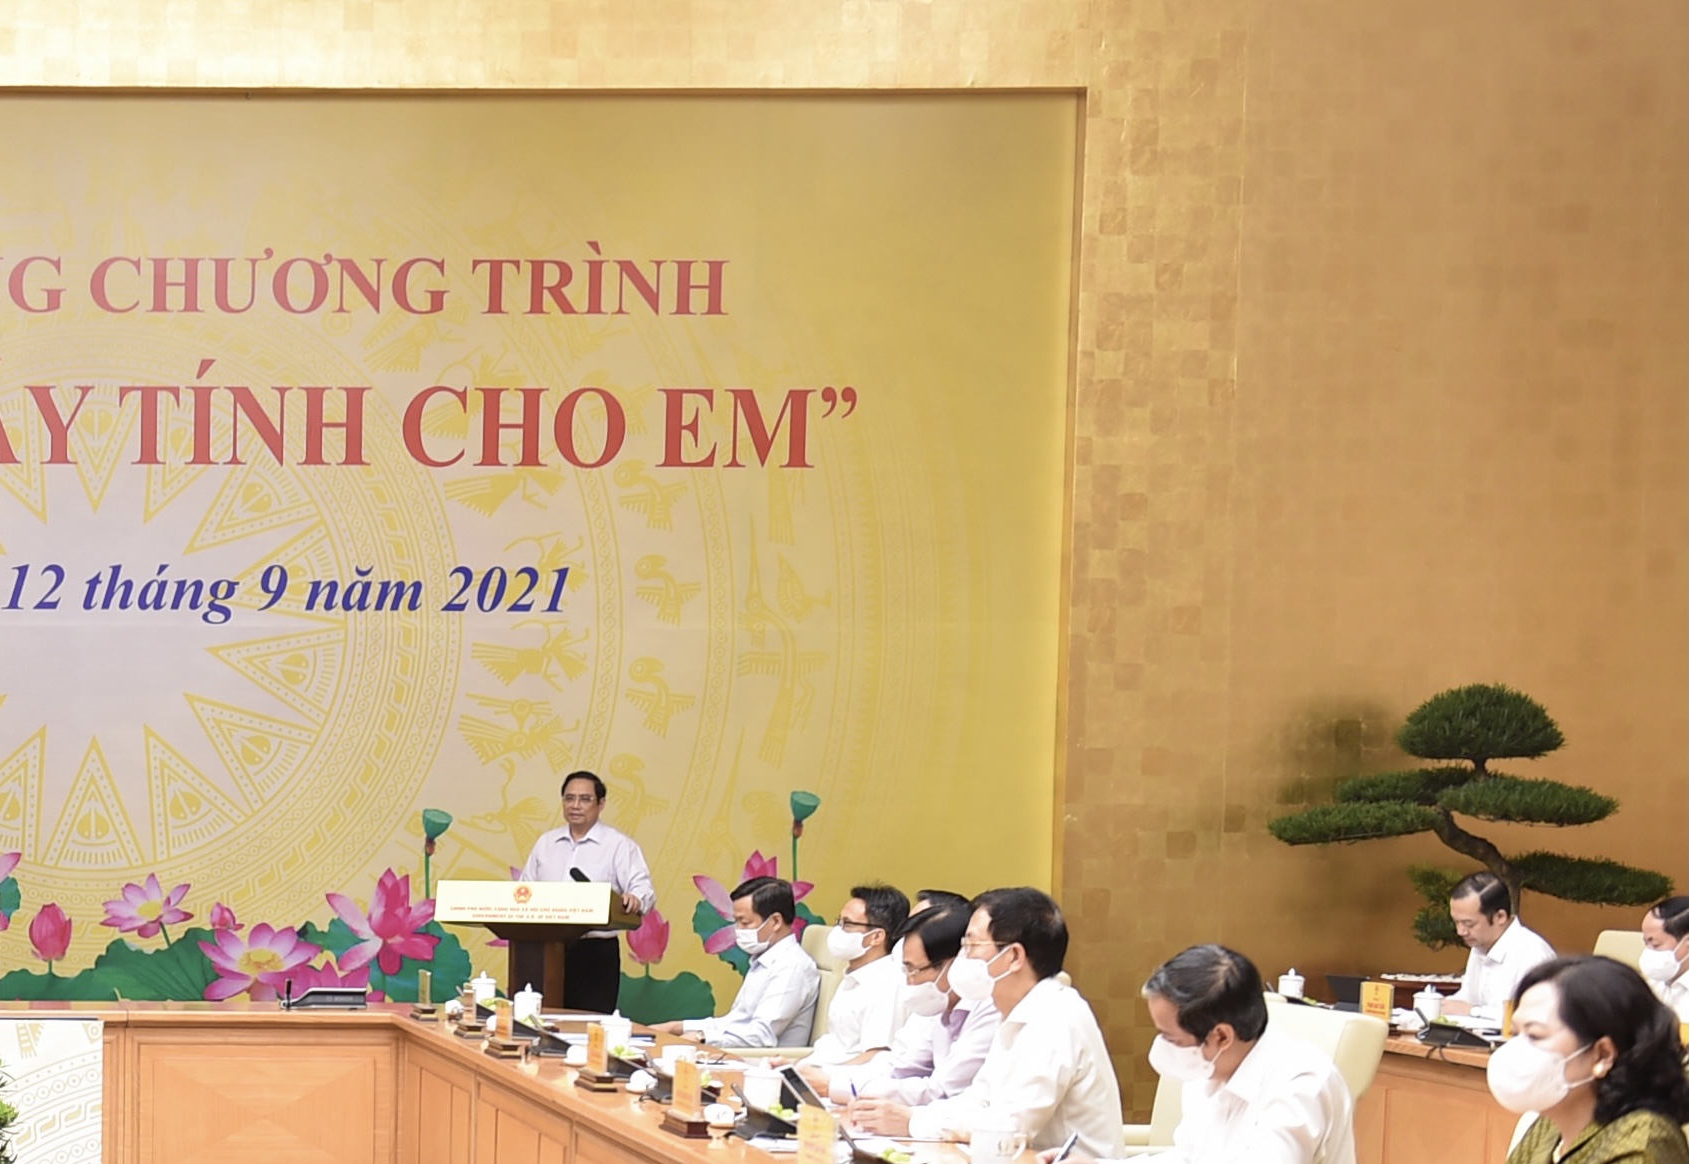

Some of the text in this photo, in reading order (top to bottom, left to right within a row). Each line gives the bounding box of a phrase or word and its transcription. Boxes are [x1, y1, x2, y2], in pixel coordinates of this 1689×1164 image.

[90, 247, 451, 316] CHƯƠNG
[471, 241, 730, 317] TRÌNH
[118, 358, 374, 467] TÍNH
[402, 384, 627, 469] CHO
[655, 386, 858, 469] EM”
[0, 564, 66, 611] 12
[83, 564, 240, 625] tháng
[258, 564, 289, 612] 9
[306, 565, 424, 613] năm
[445, 565, 572, 614] 2021
